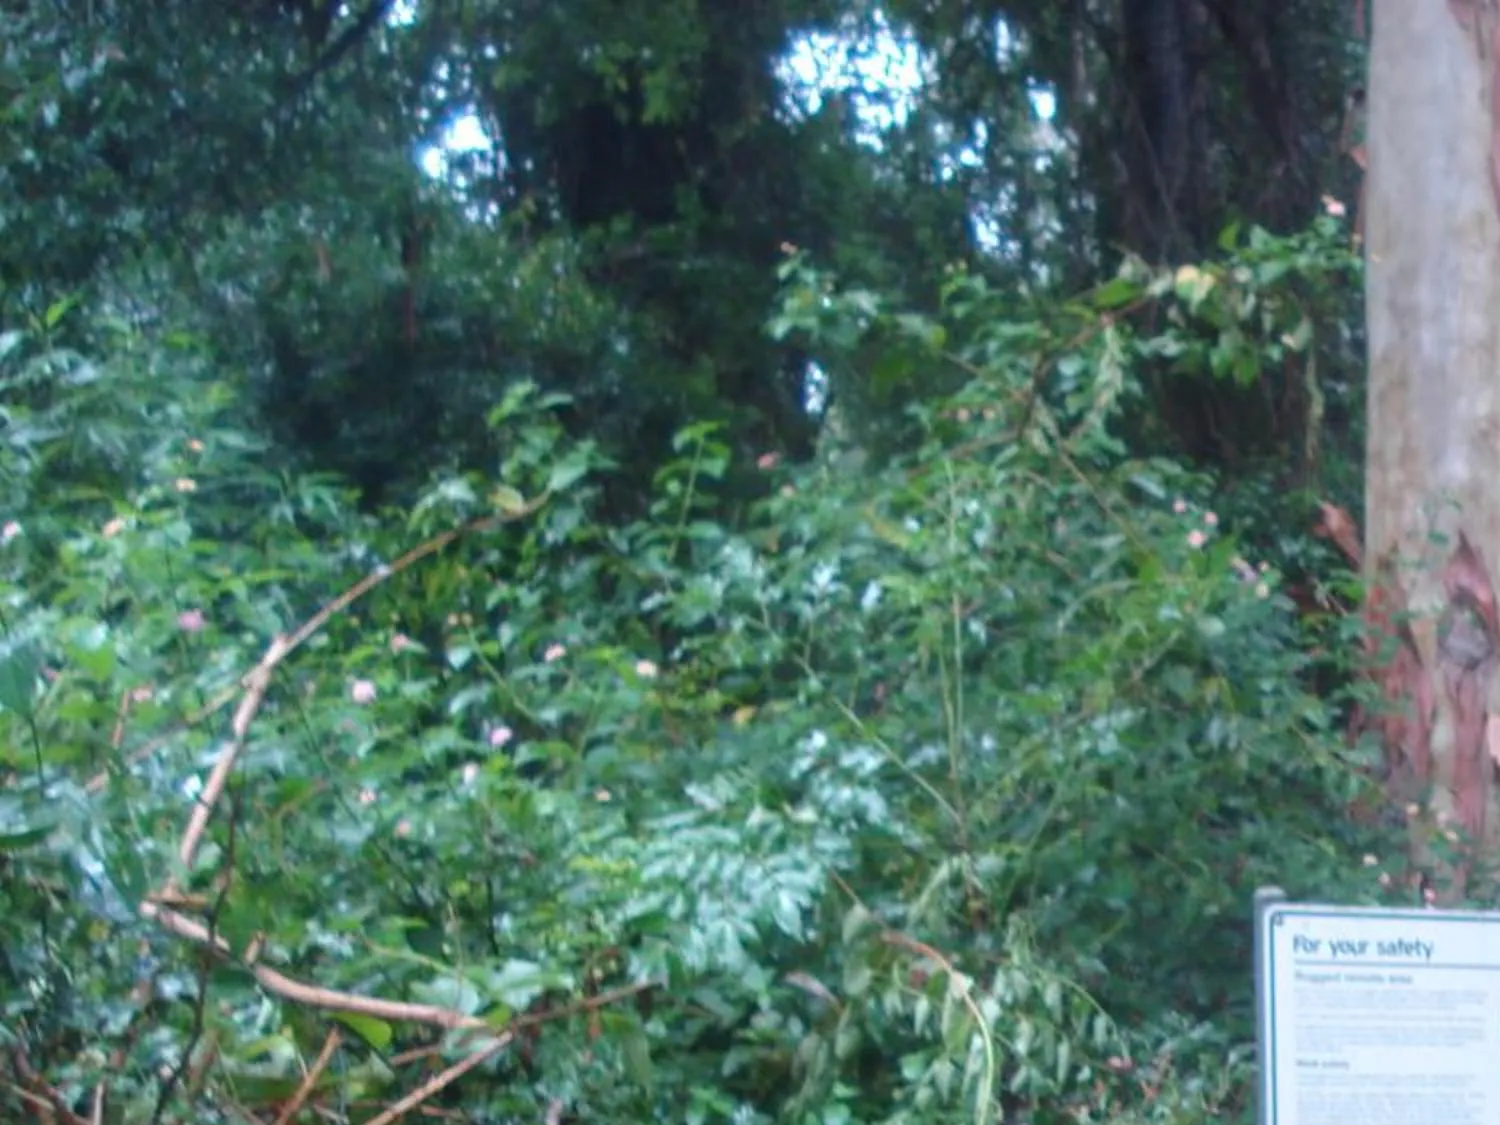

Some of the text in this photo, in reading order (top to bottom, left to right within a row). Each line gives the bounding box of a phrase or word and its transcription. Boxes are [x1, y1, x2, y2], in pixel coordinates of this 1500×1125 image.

[1293, 934, 1434, 961] For your safety
